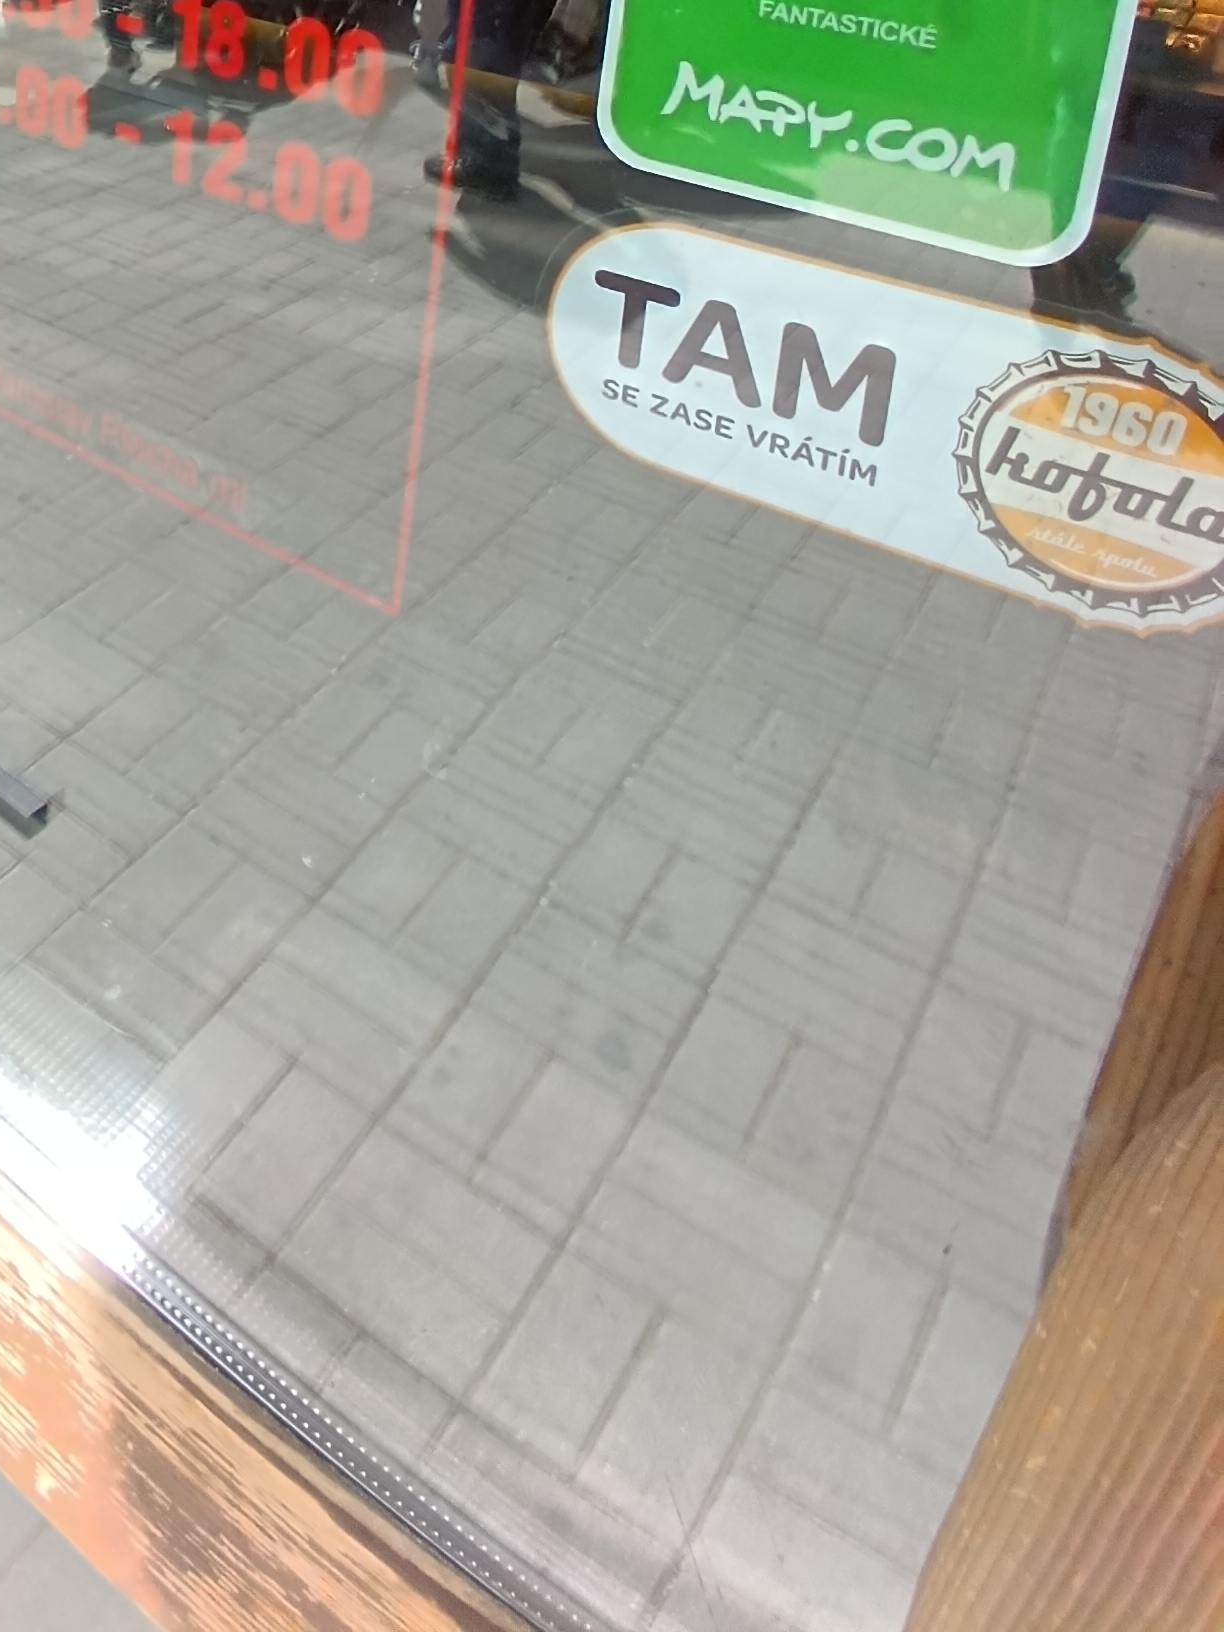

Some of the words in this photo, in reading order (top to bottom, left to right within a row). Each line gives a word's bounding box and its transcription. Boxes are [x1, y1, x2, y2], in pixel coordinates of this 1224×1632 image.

[164, 111, 373, 243] 12.00
[660, 60, 1017, 193] MAPY.COM
[594, 268, 897, 448] TAM
[601, 378, 641, 410] SE
[648, 392, 737, 441] ZASE
[745, 423, 879, 488] VRÁTÍM
[1060, 385, 1188, 457] 1960
[983, 425, 1224, 546] kofola
[1025, 524, 1089, 555] stále
[1092, 545, 1159, 578] spolu
